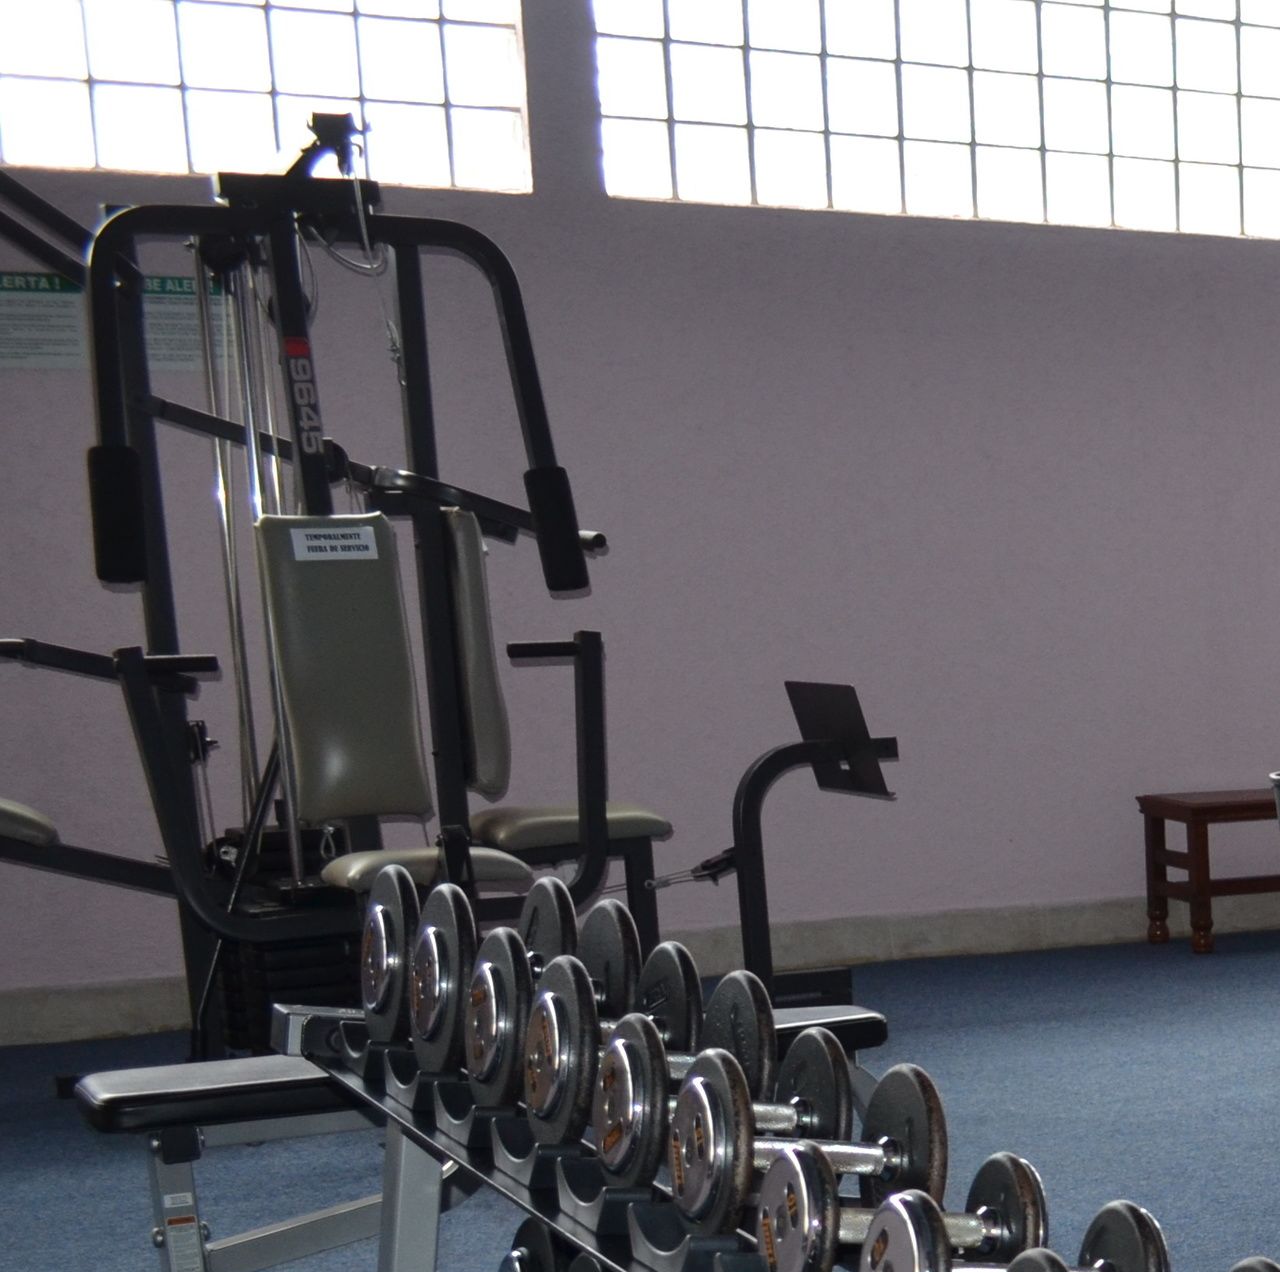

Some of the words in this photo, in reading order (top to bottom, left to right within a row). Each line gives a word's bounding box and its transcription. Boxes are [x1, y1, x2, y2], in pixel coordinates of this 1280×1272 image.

[289, 358, 324, 454] 9645
[305, 532, 361, 542] TEMPORALMENTE
[330, 544, 338, 552] DE
[340, 543, 370, 552] SERVICIO
